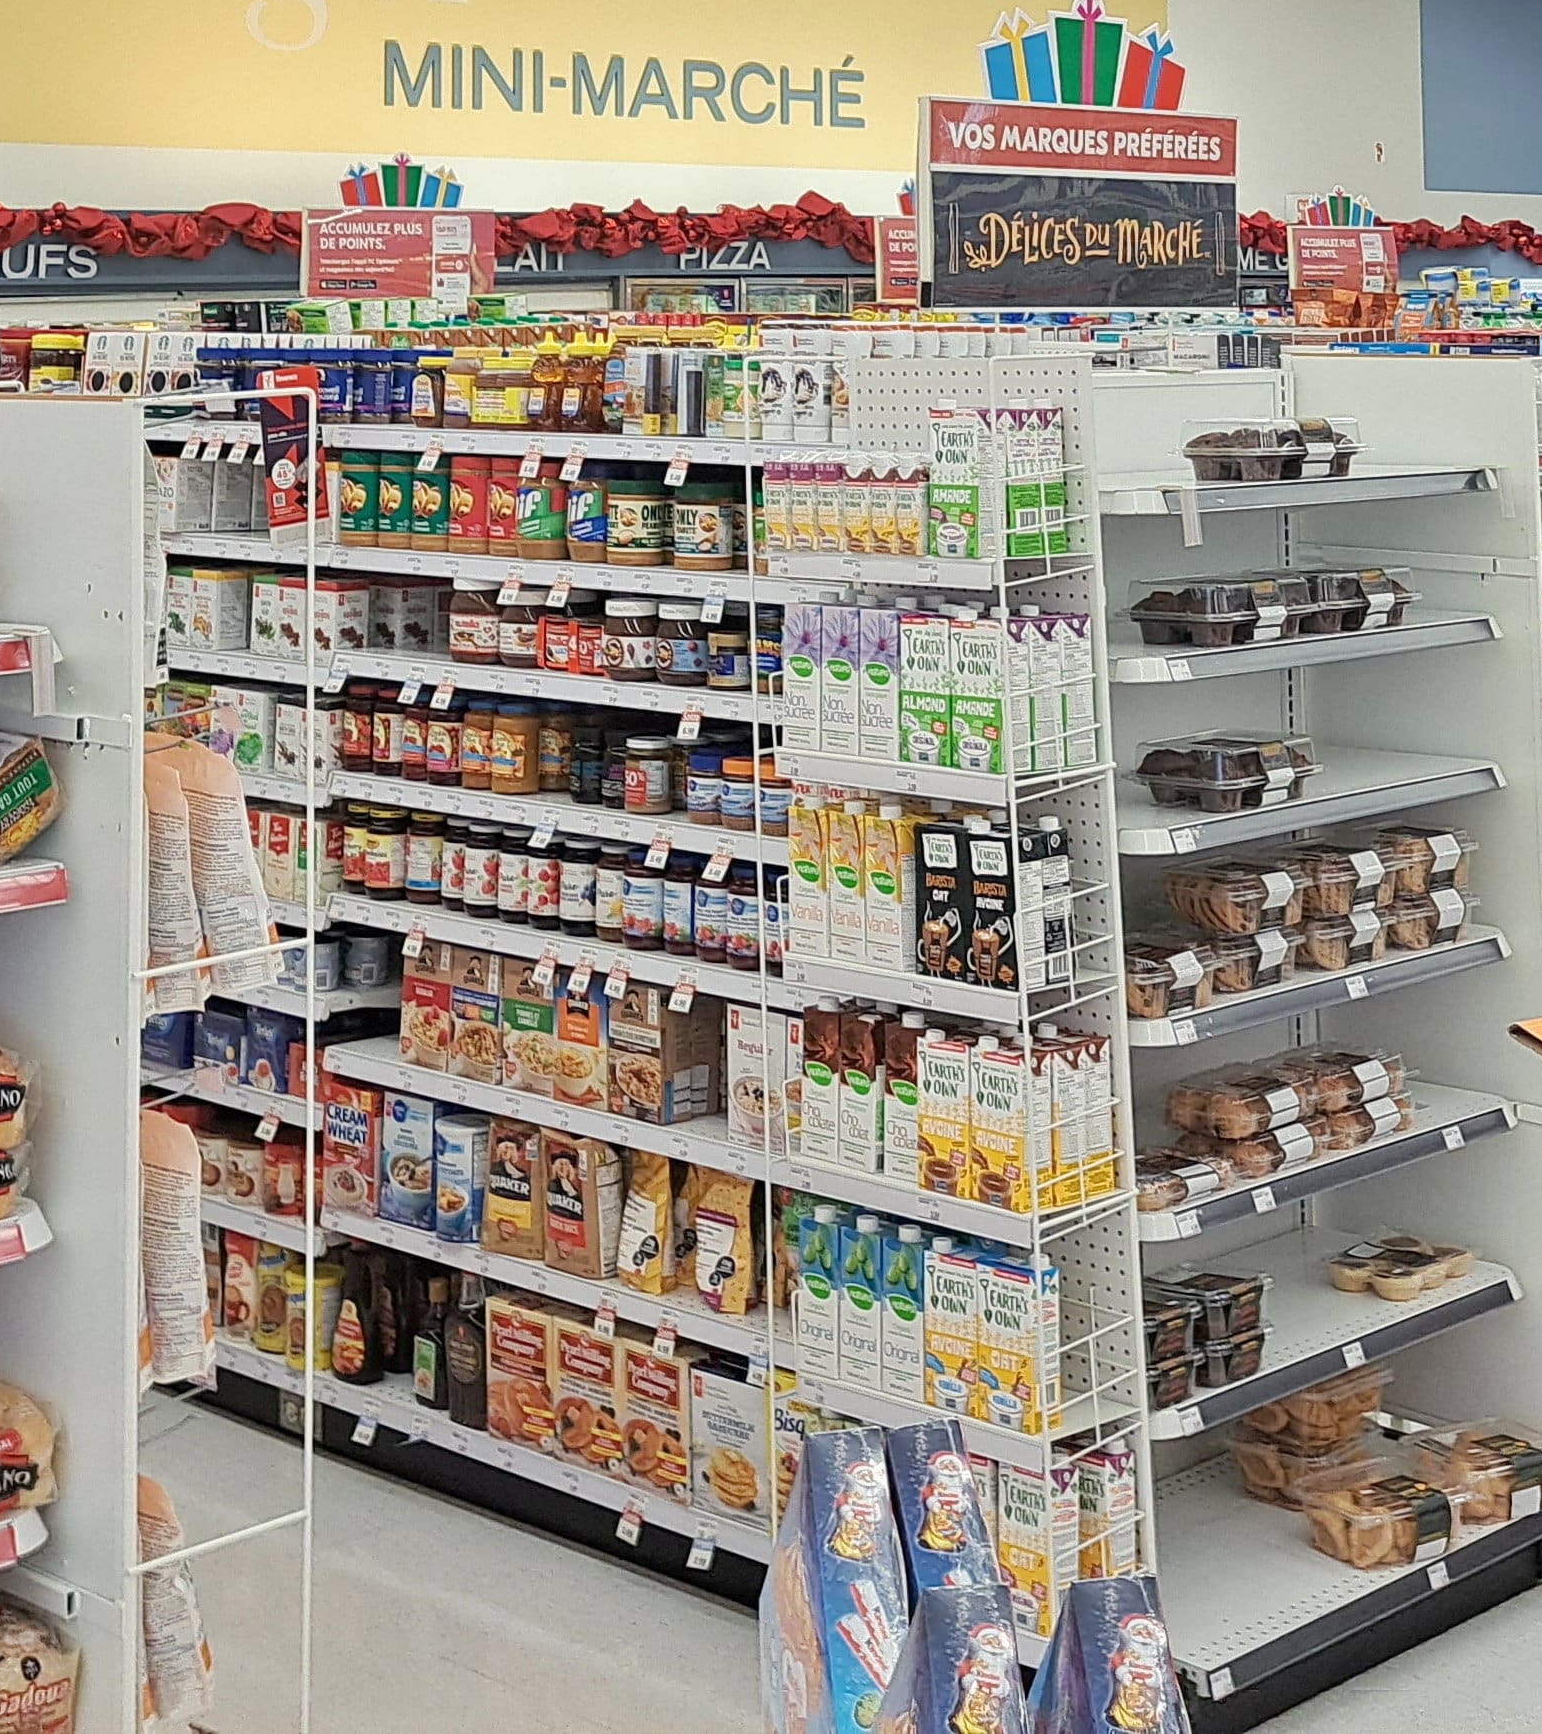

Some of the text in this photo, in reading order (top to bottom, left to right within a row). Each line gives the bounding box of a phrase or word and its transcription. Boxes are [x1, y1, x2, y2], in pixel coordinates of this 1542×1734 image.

[384, 37, 866, 130] MINI-MARCHÉ
[949, 122, 1221, 161] VOS MARQUES PRÉFÉRÉES
[320, 223, 423, 235] ACCUMULEZ PLUS
[320, 238, 386, 250] DE POINTS.
[973, 211, 1203, 269] DÉLICES DU MARCHÉ
[680, 242, 771, 270] PIZZA
[941, 431, 974, 448] EARTH'S
[945, 448, 968, 464] OWN
[933, 488, 971, 504] AMANDE
[912, 638, 946, 655] EARTH'S
[962, 644, 998, 660] EARTH'S
[917, 656, 940, 672] OWN
[968, 661, 991, 676] OWN
[902, 695, 946, 713] ALMOND
[955, 701, 996, 718] AMANDE
[926, 873, 956, 889] BARISTA
[973, 881, 1006, 897] BARISTA
[791, 904, 824, 922] Vanilla
[831, 909, 862, 927] Vanilla
[867, 914, 900, 934] Vanilla
[929, 1063, 965, 1081] EARTH'S
[934, 1080, 958, 1098] OWN
[980, 1075, 1019, 1096] EARTH'S
[986, 1092, 1012, 1111] OWN
[327, 1103, 367, 1129] CREAM
[328, 1122, 368, 1143] WHEAT
[490, 1174, 530, 1196] QUAKER
[547, 1191, 582, 1214] QUAKER
[936, 1276, 975, 1297] EARTH'S
[940, 1295, 967, 1315] OWN
[988, 1289, 1028, 1314] EARTH'S
[995, 1310, 1021, 1330] OWN
[1010, 1489, 1046, 1512] EARTH'S
[1014, 1508, 1039, 1526] OWN
